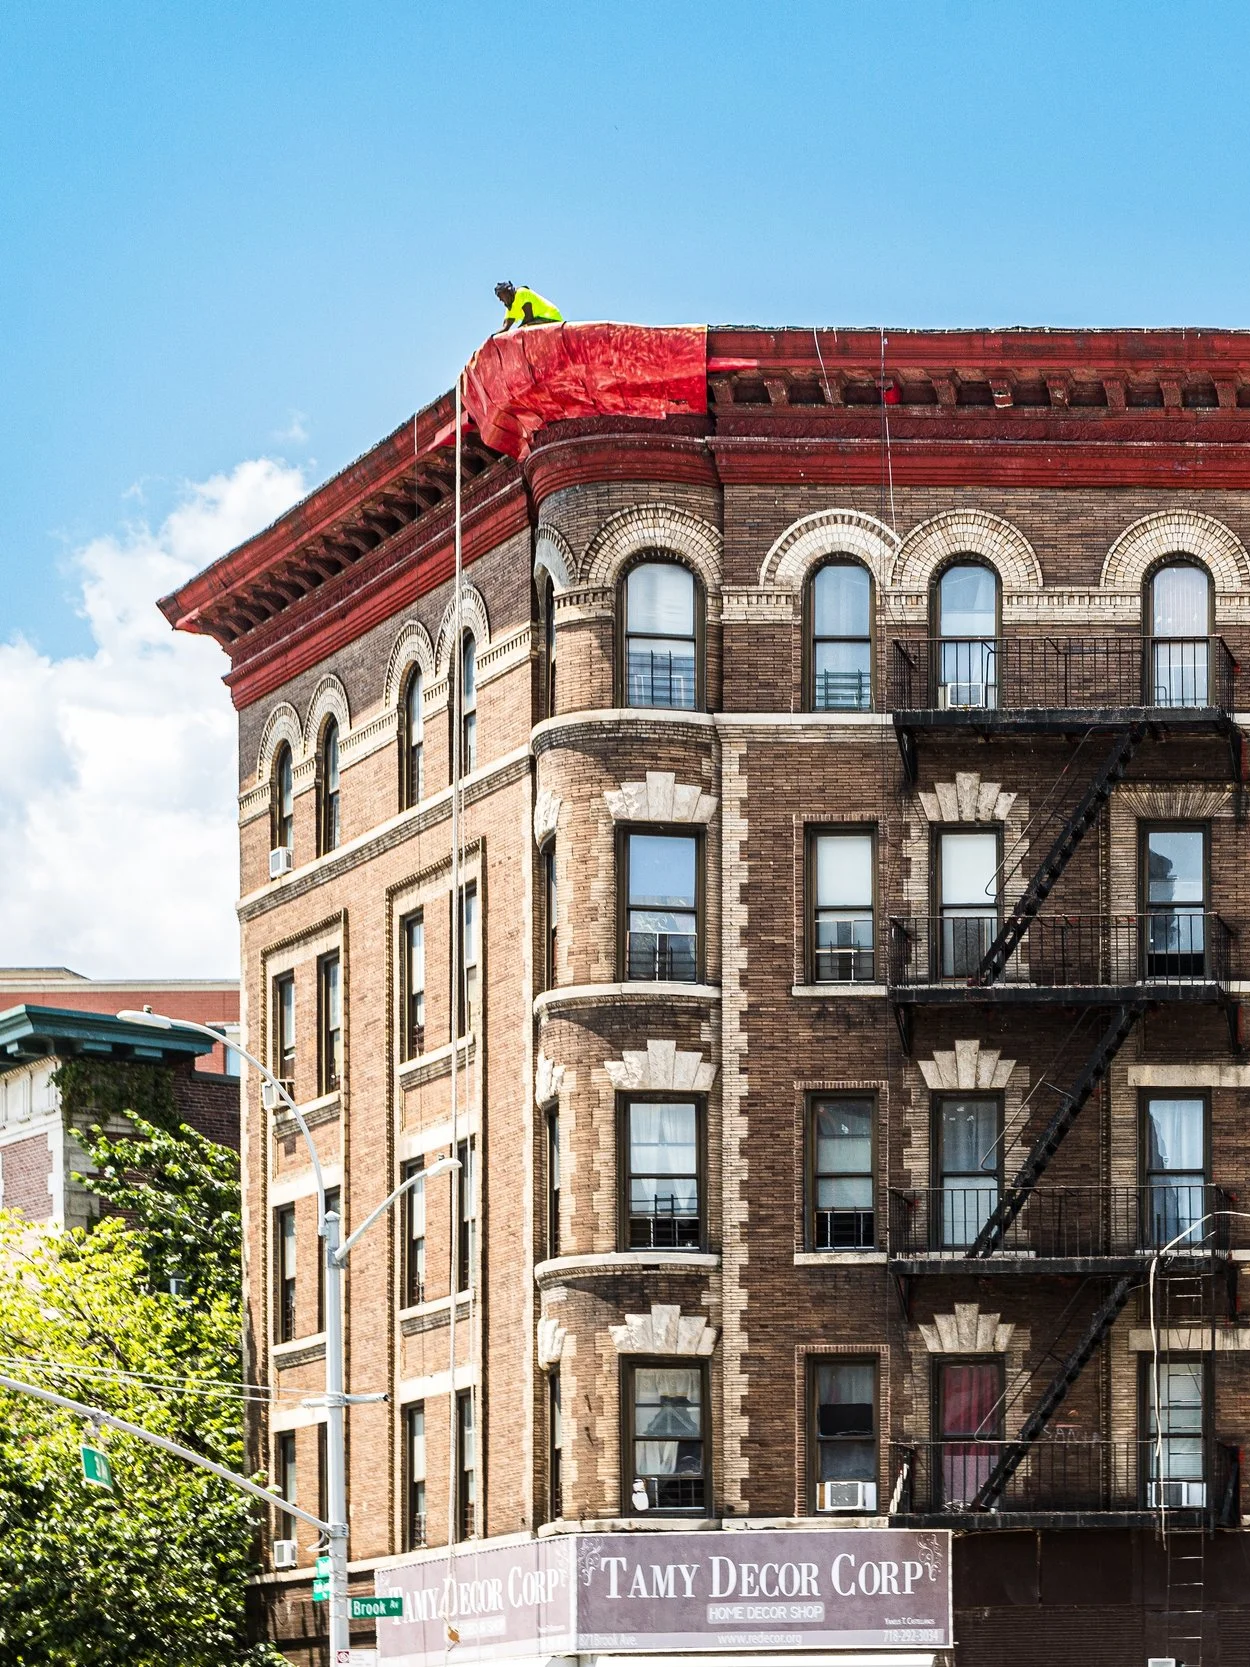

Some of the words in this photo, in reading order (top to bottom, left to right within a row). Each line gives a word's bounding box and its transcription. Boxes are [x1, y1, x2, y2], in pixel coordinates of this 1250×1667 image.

[601, 1556, 700, 1599] TAMY
[708, 1556, 821, 1598] DECOR
[831, 1553, 924, 1597] CORP
[508, 1565, 560, 1609] CORP
[353, 1600, 386, 1616] Brook
[709, 1606, 745, 1620] HOME
[747, 1606, 788, 1620] DECOR
[790, 1605, 823, 1619] SHOP
[594, 1633, 619, 1647] Brook
